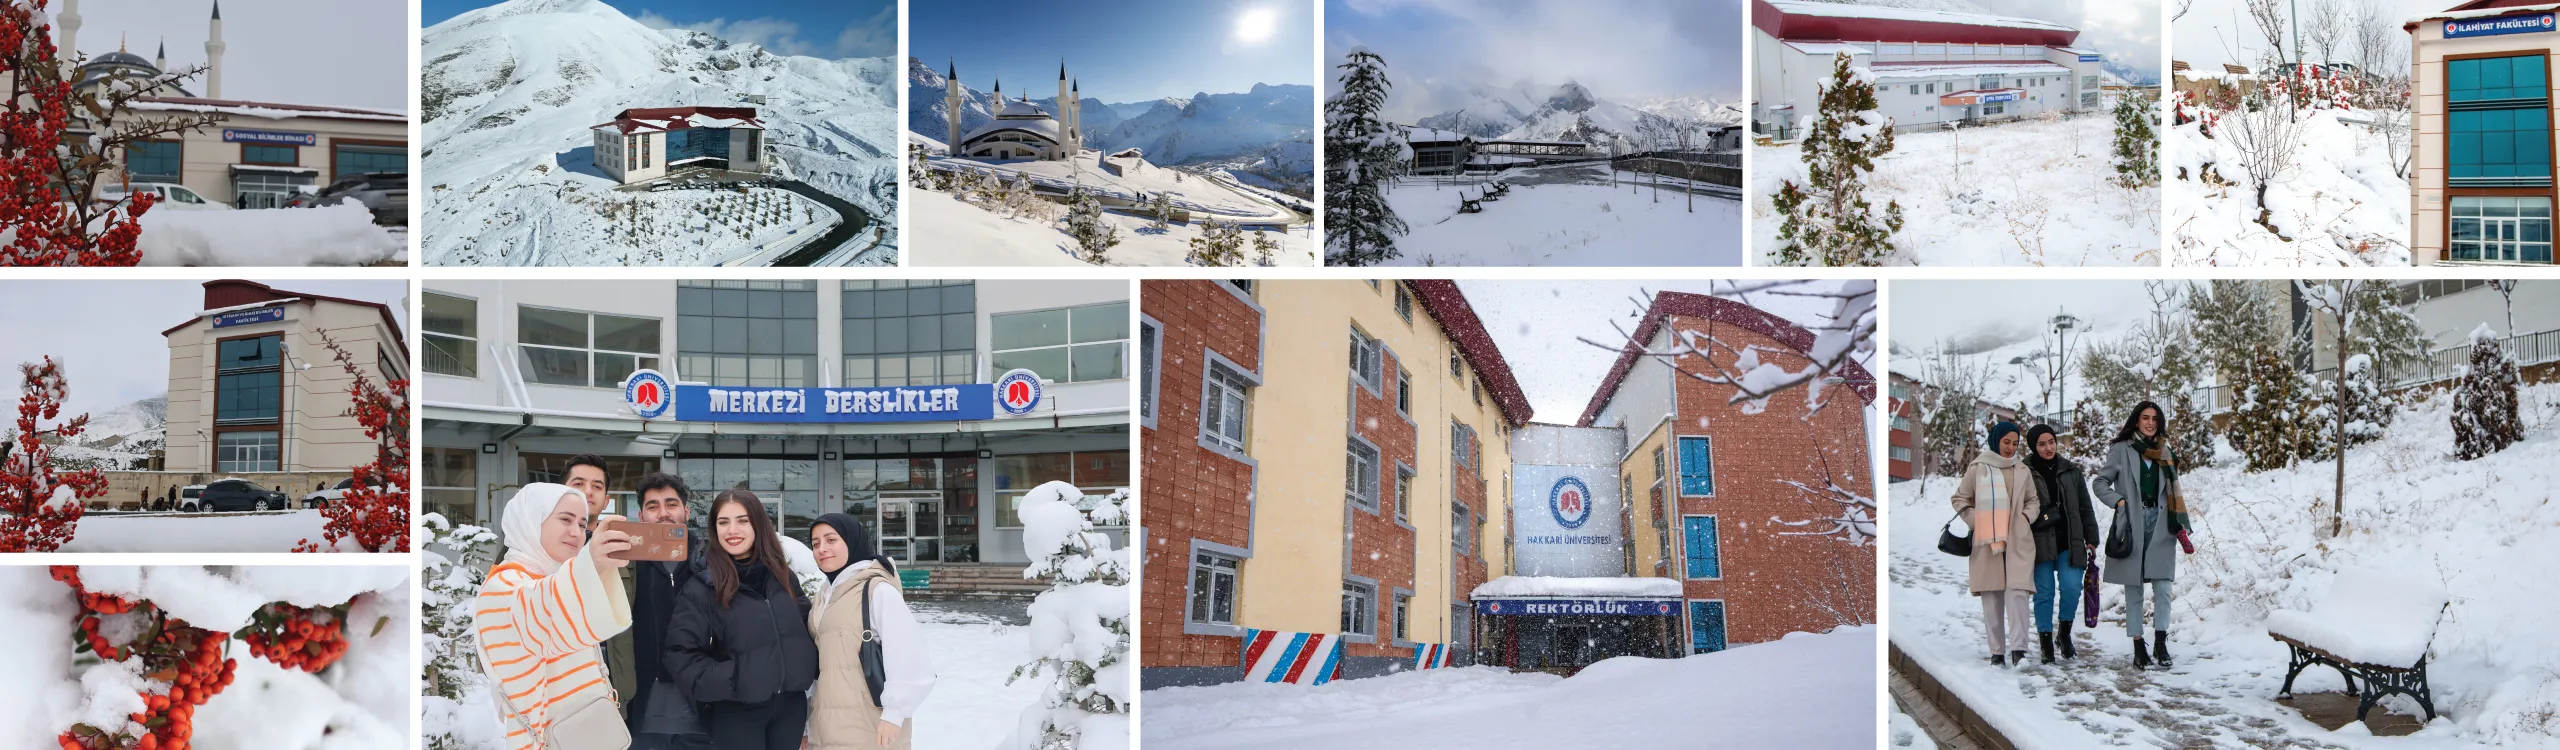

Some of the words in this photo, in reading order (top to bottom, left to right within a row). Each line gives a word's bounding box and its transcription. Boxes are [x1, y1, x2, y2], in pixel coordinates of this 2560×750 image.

[2458, 23, 2494, 32] İLAHİYAT
[2496, 18, 2540, 29] FAKÜLTESİ
[236, 132, 257, 140] SOSYAL
[709, 389, 805, 413] MERKEZİ
[825, 387, 959, 413] DERSLİKLER
[1564, 534, 1611, 545] ÜNİVERSİTESİ
[1526, 599, 1628, 614] REKTÖRLÜK
